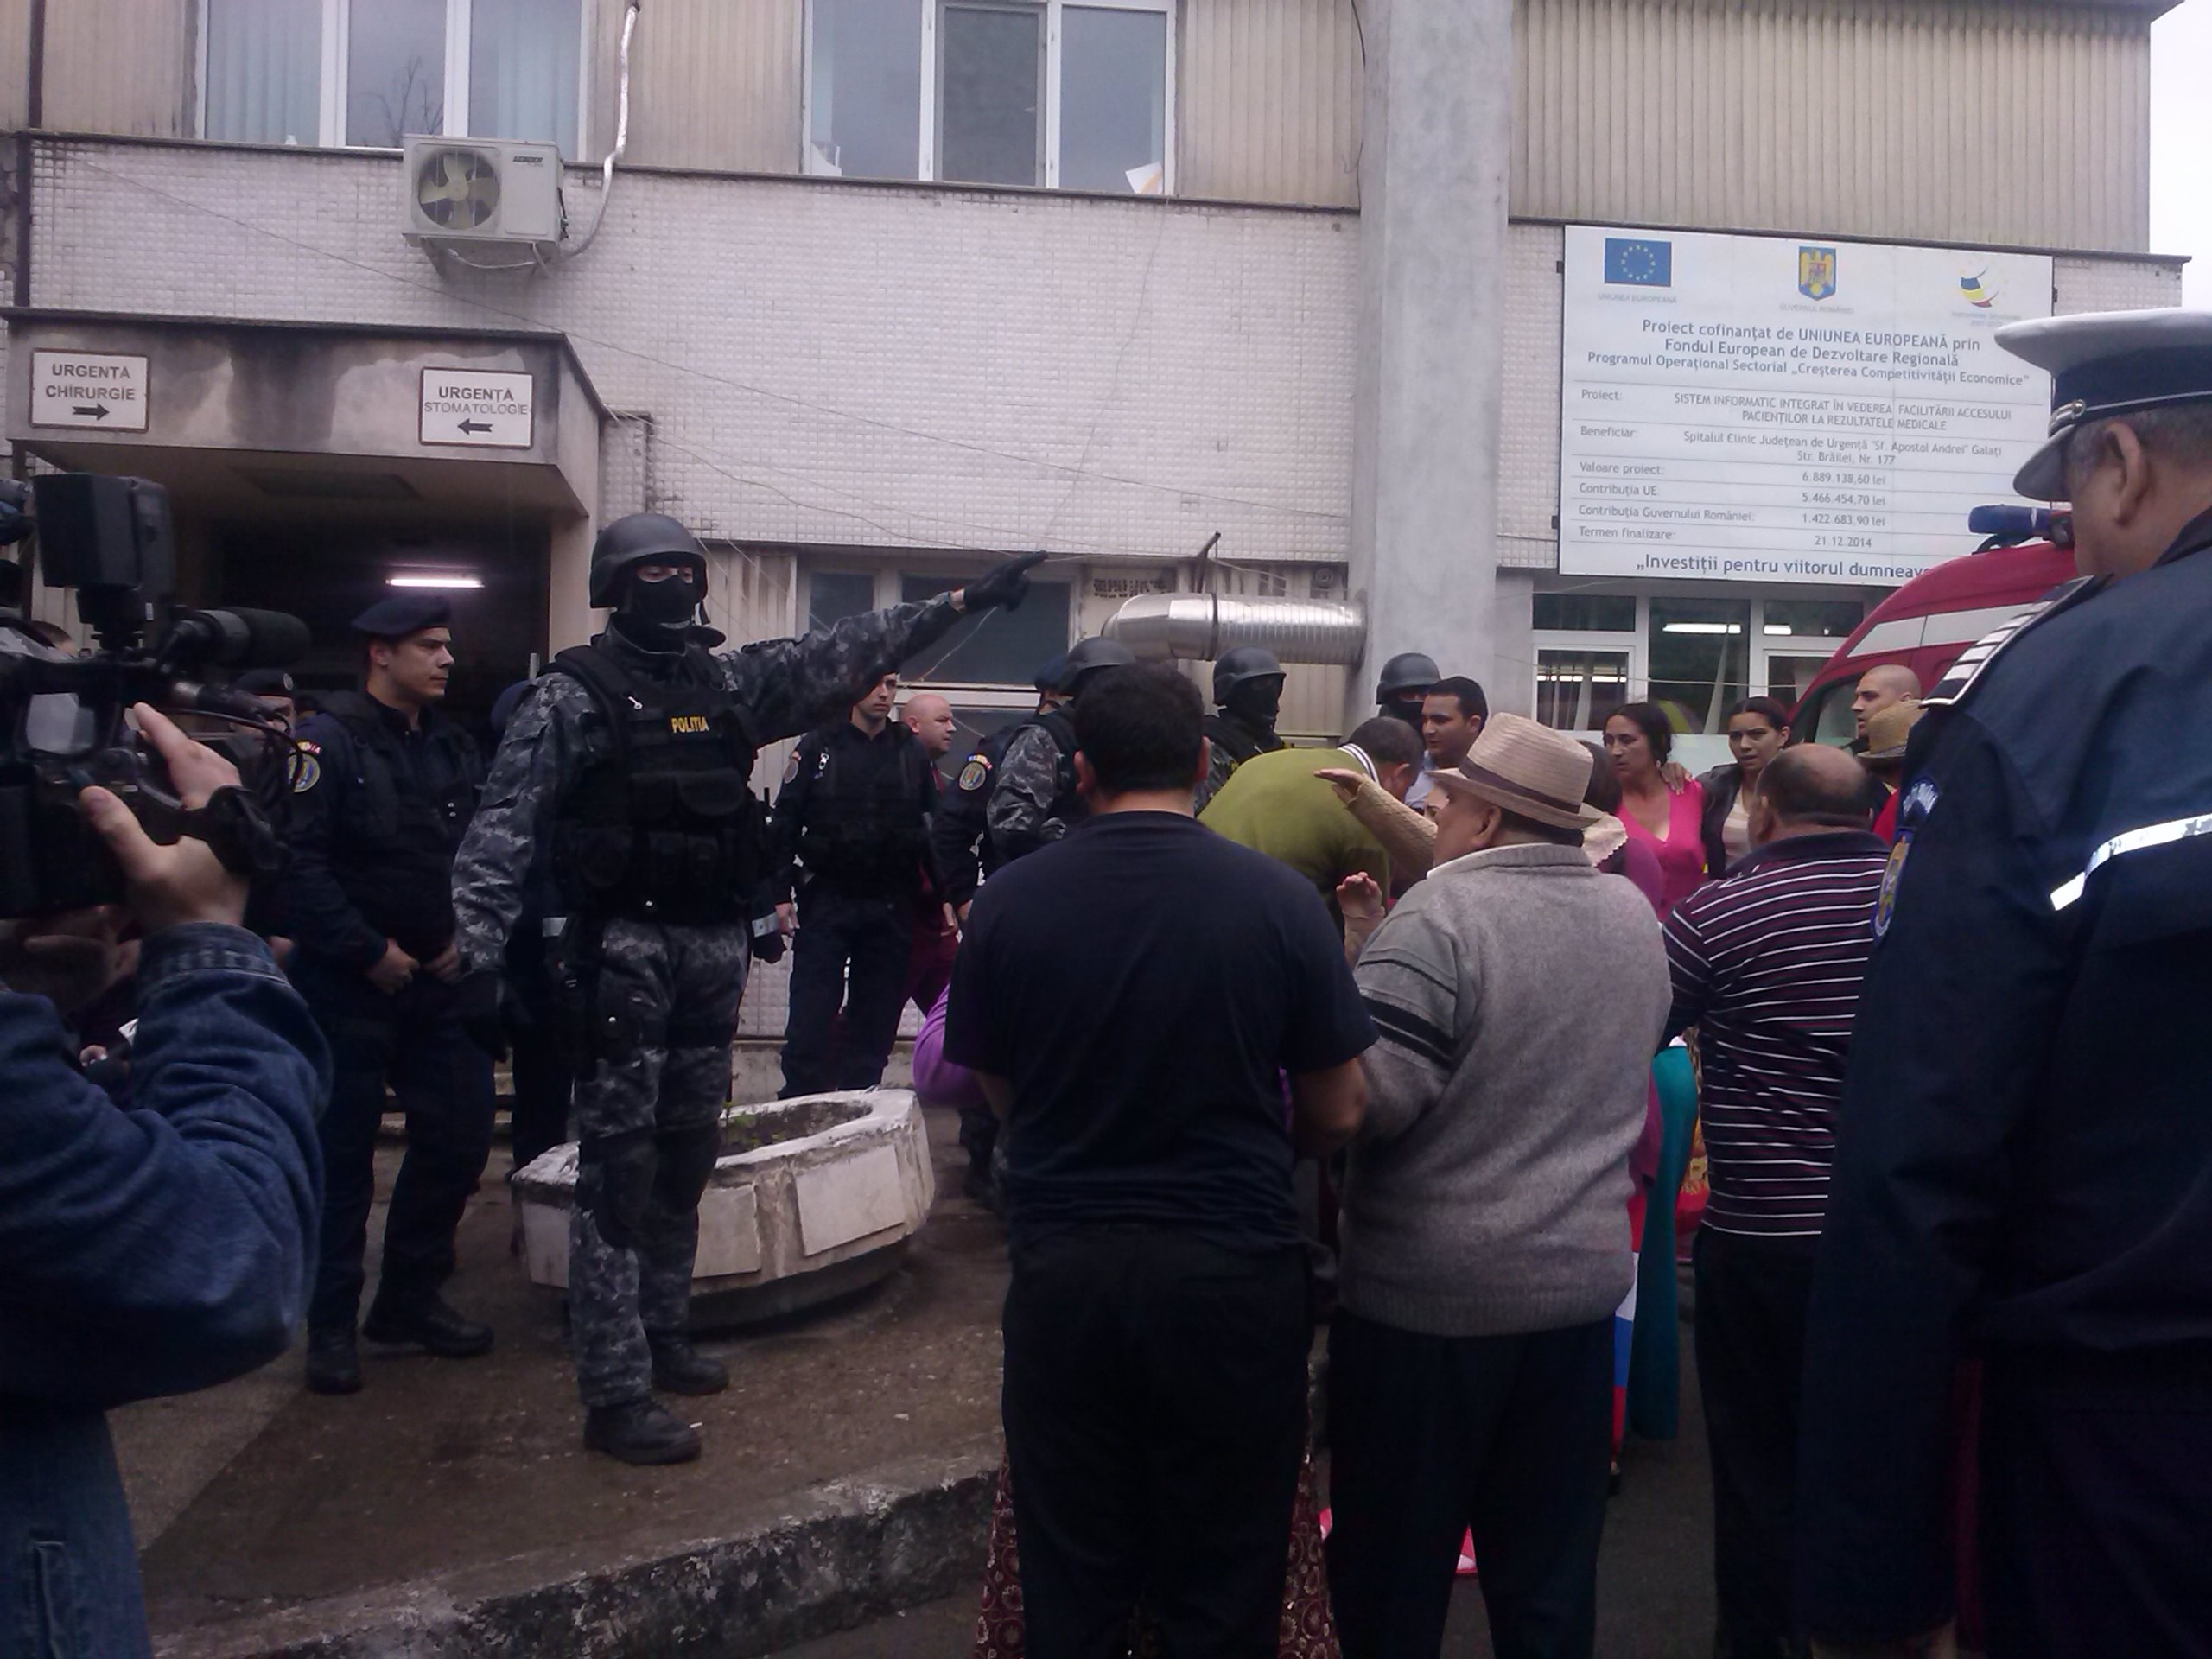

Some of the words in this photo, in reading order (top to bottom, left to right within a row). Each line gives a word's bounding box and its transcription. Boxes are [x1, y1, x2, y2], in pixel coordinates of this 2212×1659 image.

[1643, 319, 1694, 334] Proiect
[1777, 327, 1794, 340] de
[1798, 327, 1861, 344] UNIUNEA
[1865, 332, 1948, 349] EUROPEANĂ
[1952, 338, 1980, 353] prin
[1664, 338, 1713, 354] Fondul
[1718, 341, 1785, 359] European
[1790, 346, 1808, 359] de
[1812, 346, 1888, 364] Dezvoltare
[1892, 352, 1959, 368] Regională
[1587, 352, 1652, 366] Programul
[1732, 359, 1787, 373] Sectorial
[1581, 389, 1622, 402] Proiect:
[423, 401, 528, 415] STOMATOLOGIE
[1674, 392, 1711, 405] SISTEM
[1714, 395, 1777, 409] INFORMATIC
[1780, 397, 1830, 411] INTEGRAT
[1833, 399, 1846, 411] ÎN
[1847, 402, 1892, 415] VEDEREA
[1898, 404, 1955, 417] FACILITĂRII
[1957, 407, 2011, 420] ACCESULUI
[1812, 413, 1824, 424] LA
[1827, 416, 1893, 429] REZULTATELE
[1897, 420, 1947, 430] MEDICALE
[1683, 431, 1724, 443] Spitalul
[1727, 433, 1757, 445] Clinic
[1810, 438, 1824, 448] de
[1891, 442, 1929, 454] Apostol
[1878, 455, 1896, 465] 177
[1580, 461, 1620, 474] Valoare
[1623, 464, 1665, 476] proiect:
[1802, 472, 1870, 485] 6.889.138,60
[1872, 474, 1886, 486] lei
[1802, 493, 1870, 505] 5.466.454,70
[1872, 495, 1885, 506] lei
[1642, 507, 1700, 520] Guvernului
[1872, 517, 1885, 527] lei
[1579, 525, 1618, 537] Termen
[1621, 527, 1675, 540] finalizare:
[1814, 535, 1872, 548] 21.12.2014
[1723, 559, 1778, 575] pentru
[1783, 560, 1844, 575] viitorul
